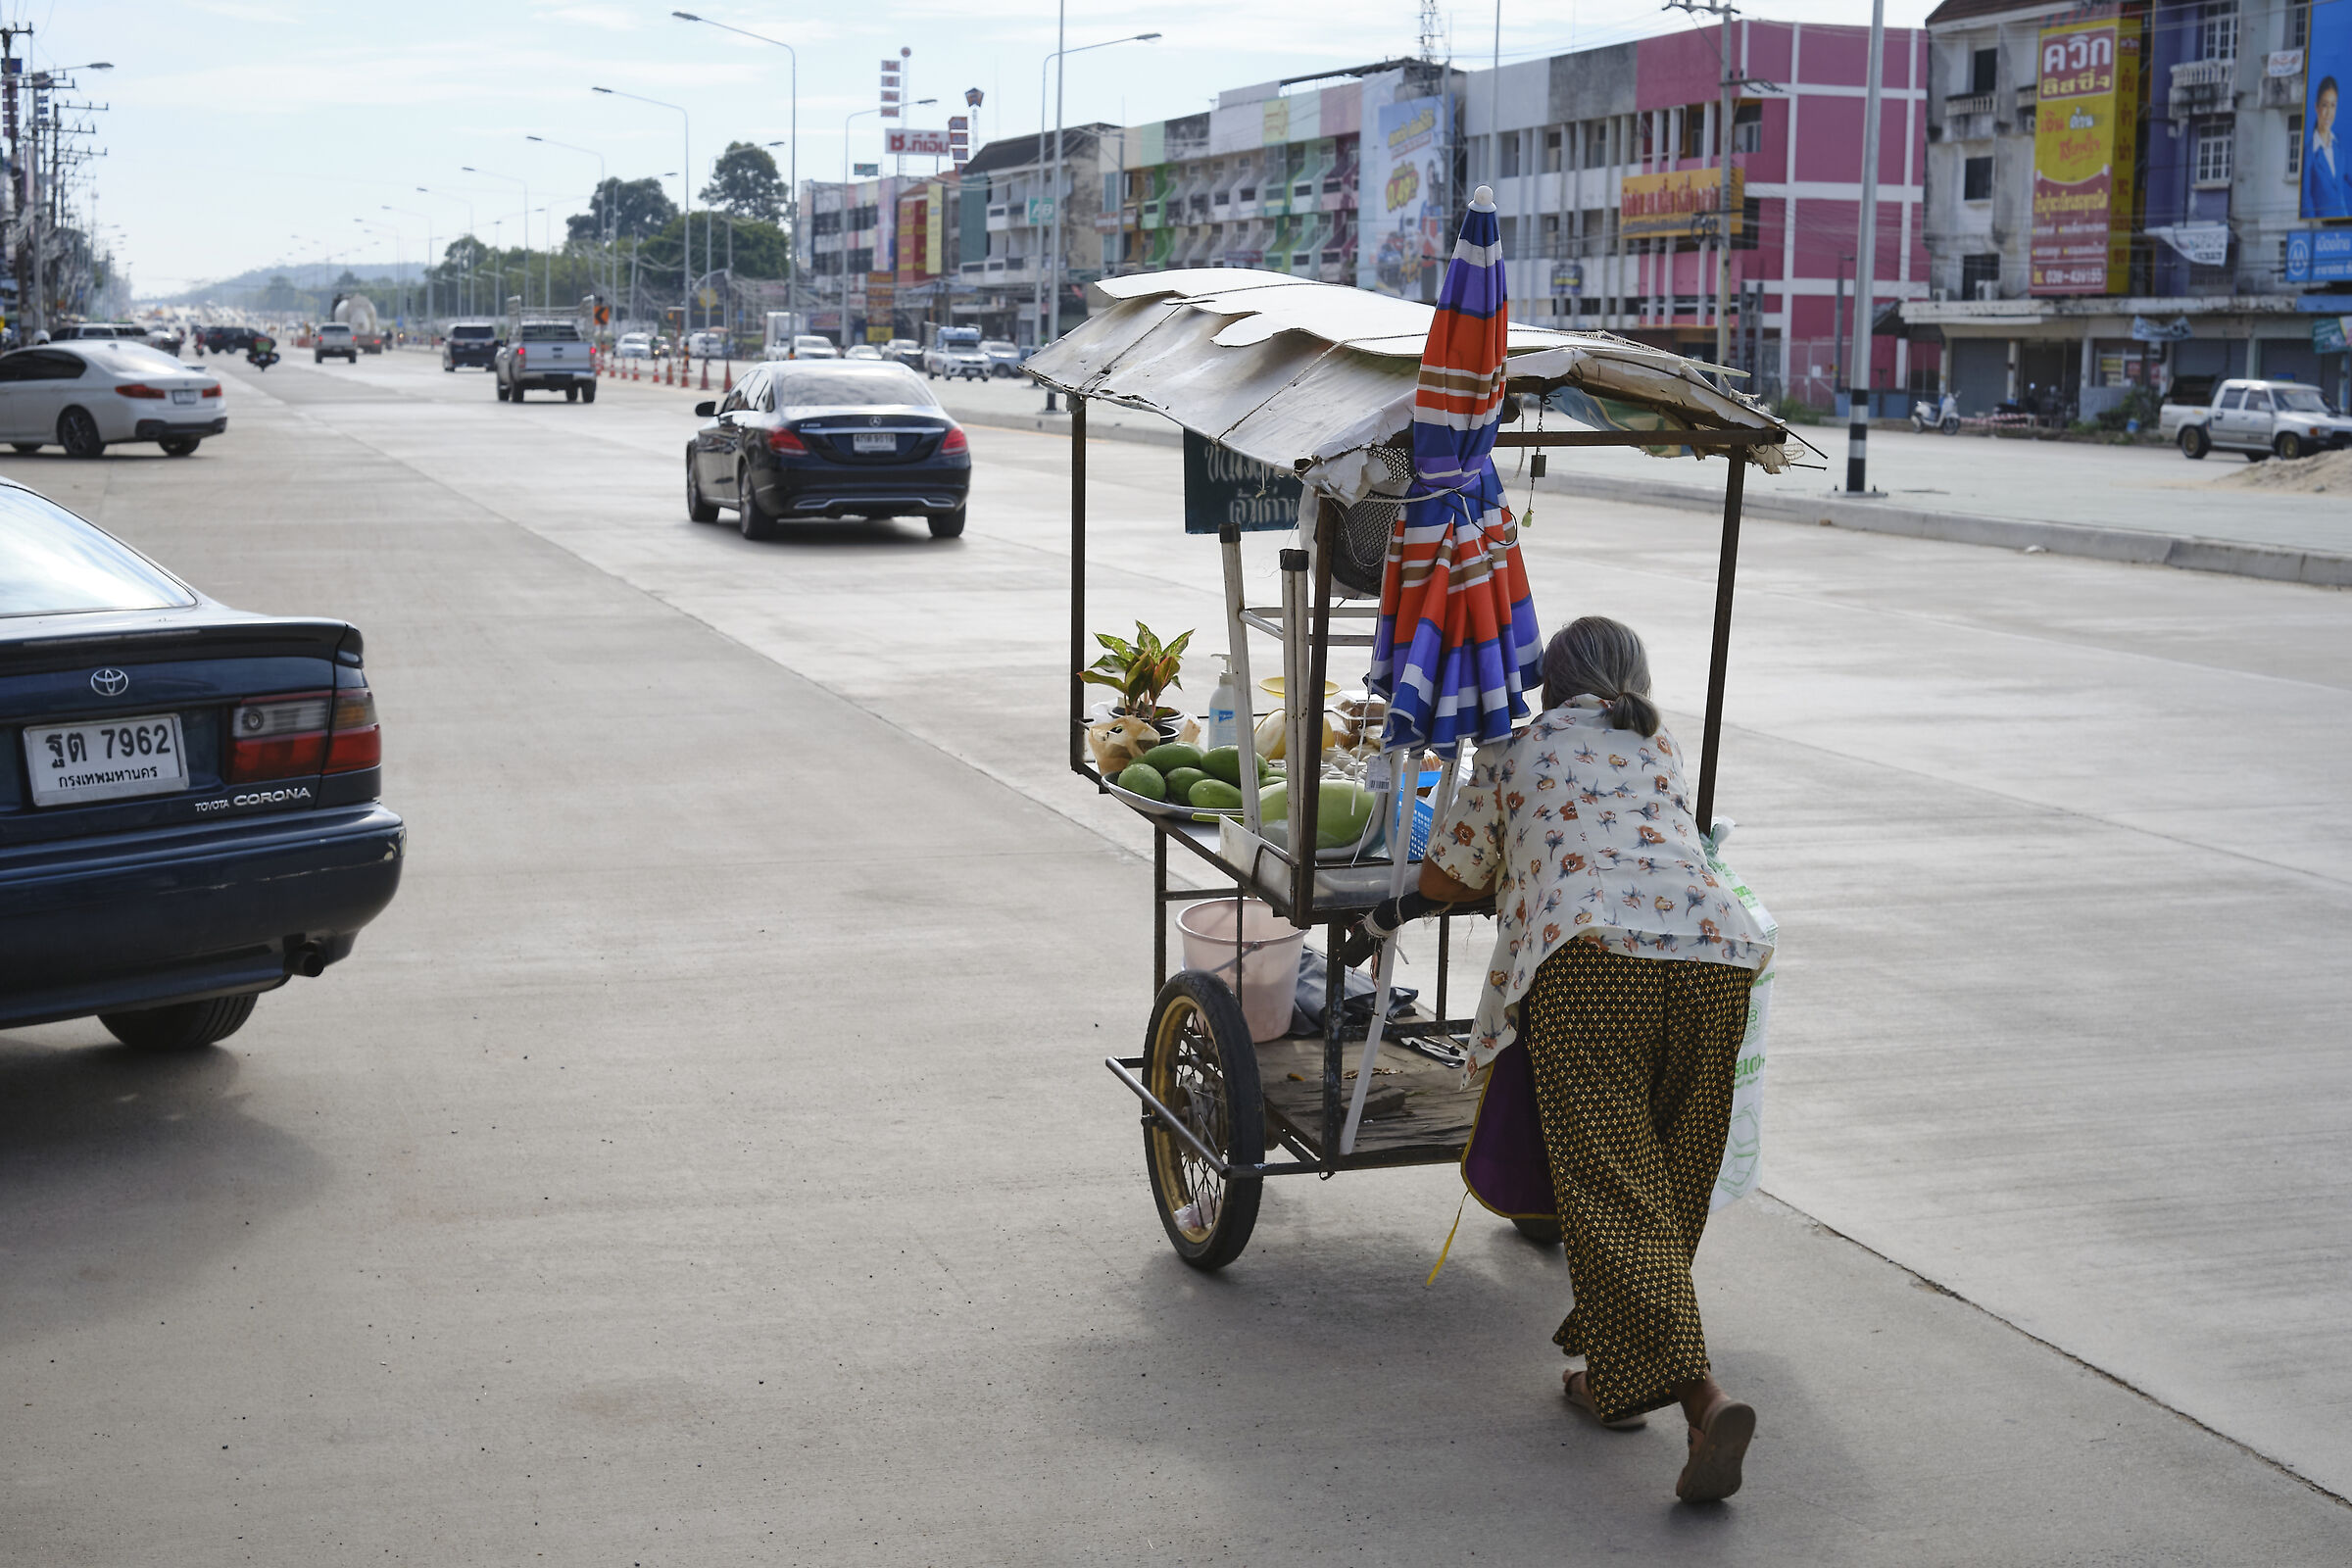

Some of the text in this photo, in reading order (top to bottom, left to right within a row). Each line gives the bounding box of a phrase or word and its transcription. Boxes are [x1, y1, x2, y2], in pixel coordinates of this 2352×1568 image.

[2043, 34, 2111, 74] ควิก
[2042, 68, 2111, 96] ลิสซิ่ง
[46, 723, 171, 769] ฐต 7962
[59, 765, 158, 791] กรุงเทพมหานคร
[195, 787, 312, 812] TOYOTA CORONA
